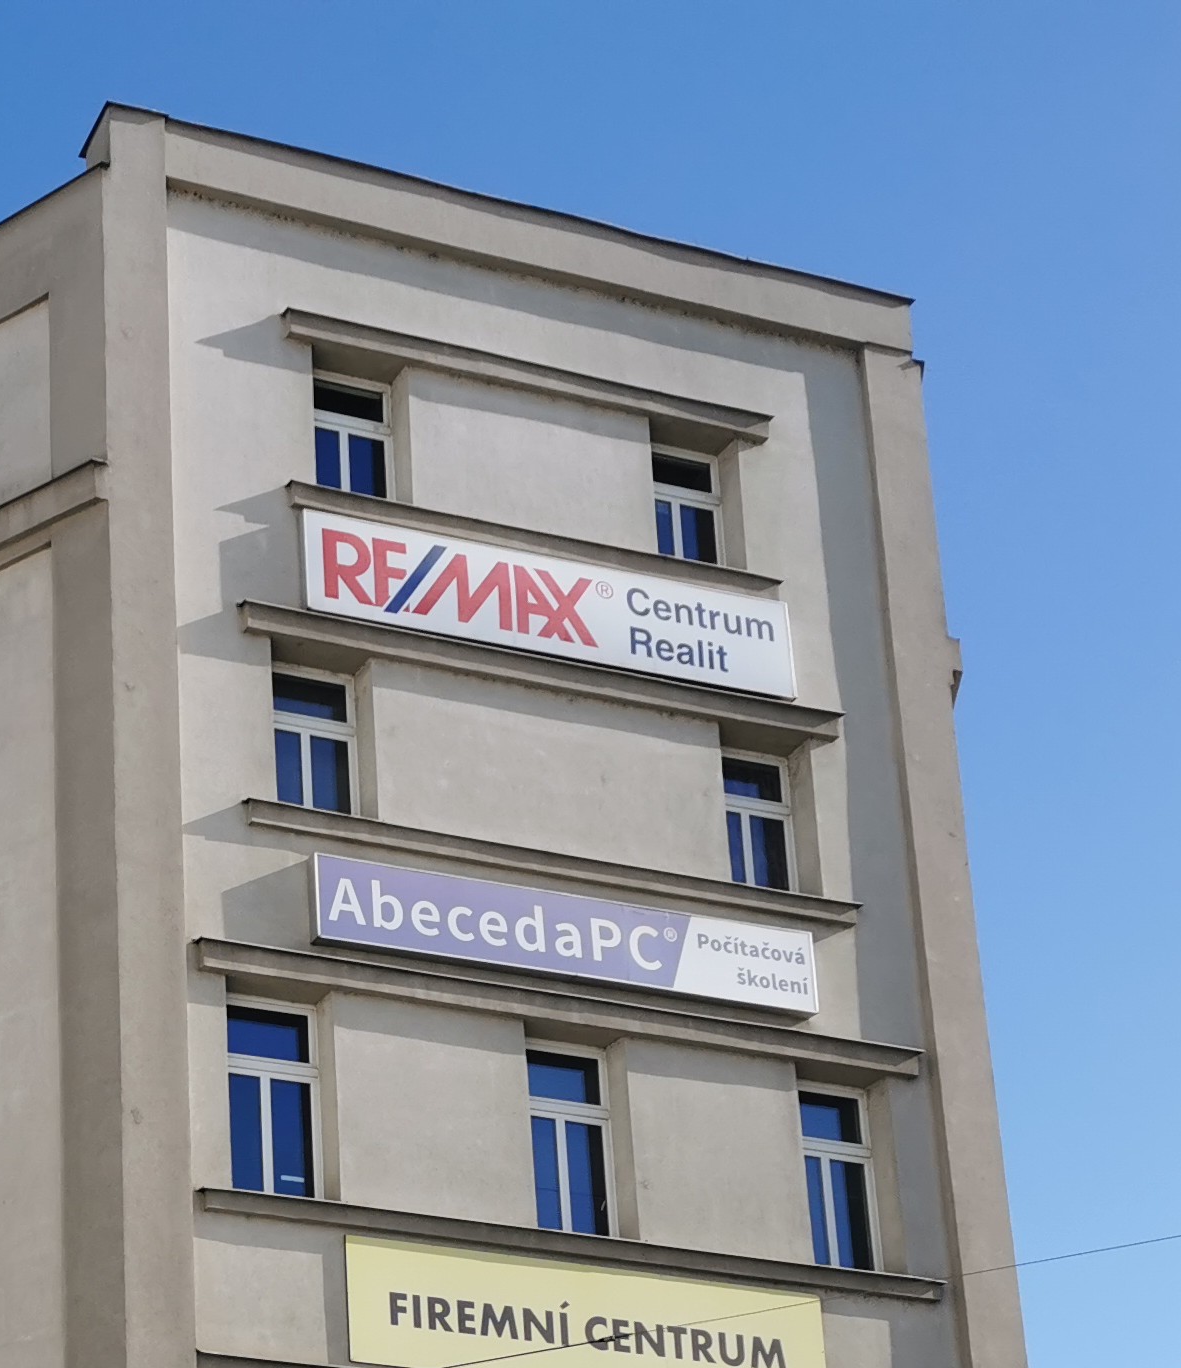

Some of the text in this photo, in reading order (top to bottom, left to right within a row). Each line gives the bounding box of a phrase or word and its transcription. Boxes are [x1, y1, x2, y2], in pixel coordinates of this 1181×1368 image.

[626, 587, 775, 642] Centrum
[629, 626, 729, 673] Realit
[697, 930, 806, 967] Počítačová
[736, 966, 809, 997] školení
[389, 1291, 569, 1347] FIREMNÍ
